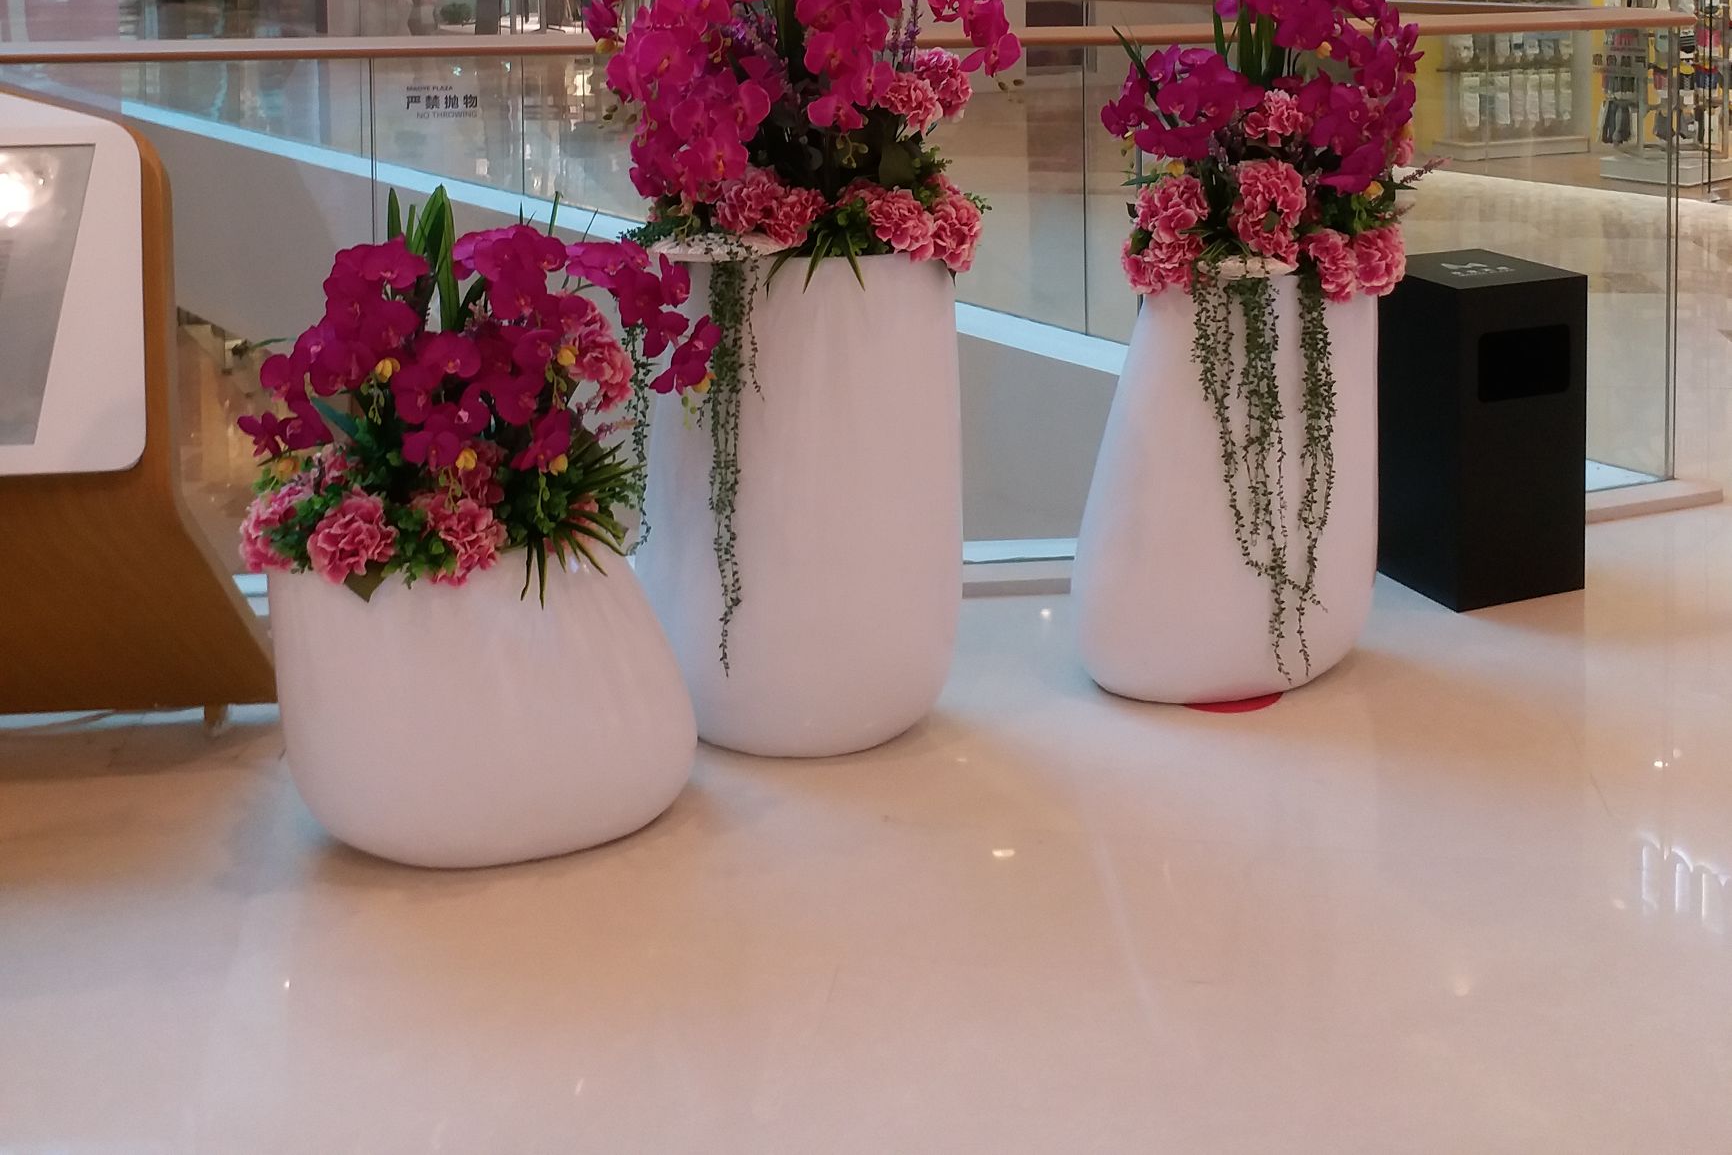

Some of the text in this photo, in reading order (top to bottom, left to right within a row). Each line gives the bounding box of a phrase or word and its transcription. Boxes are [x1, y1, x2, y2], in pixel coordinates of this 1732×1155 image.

[406, 94, 478, 110] 严禁抛物
[416, 110, 478, 119] NO THROWING
